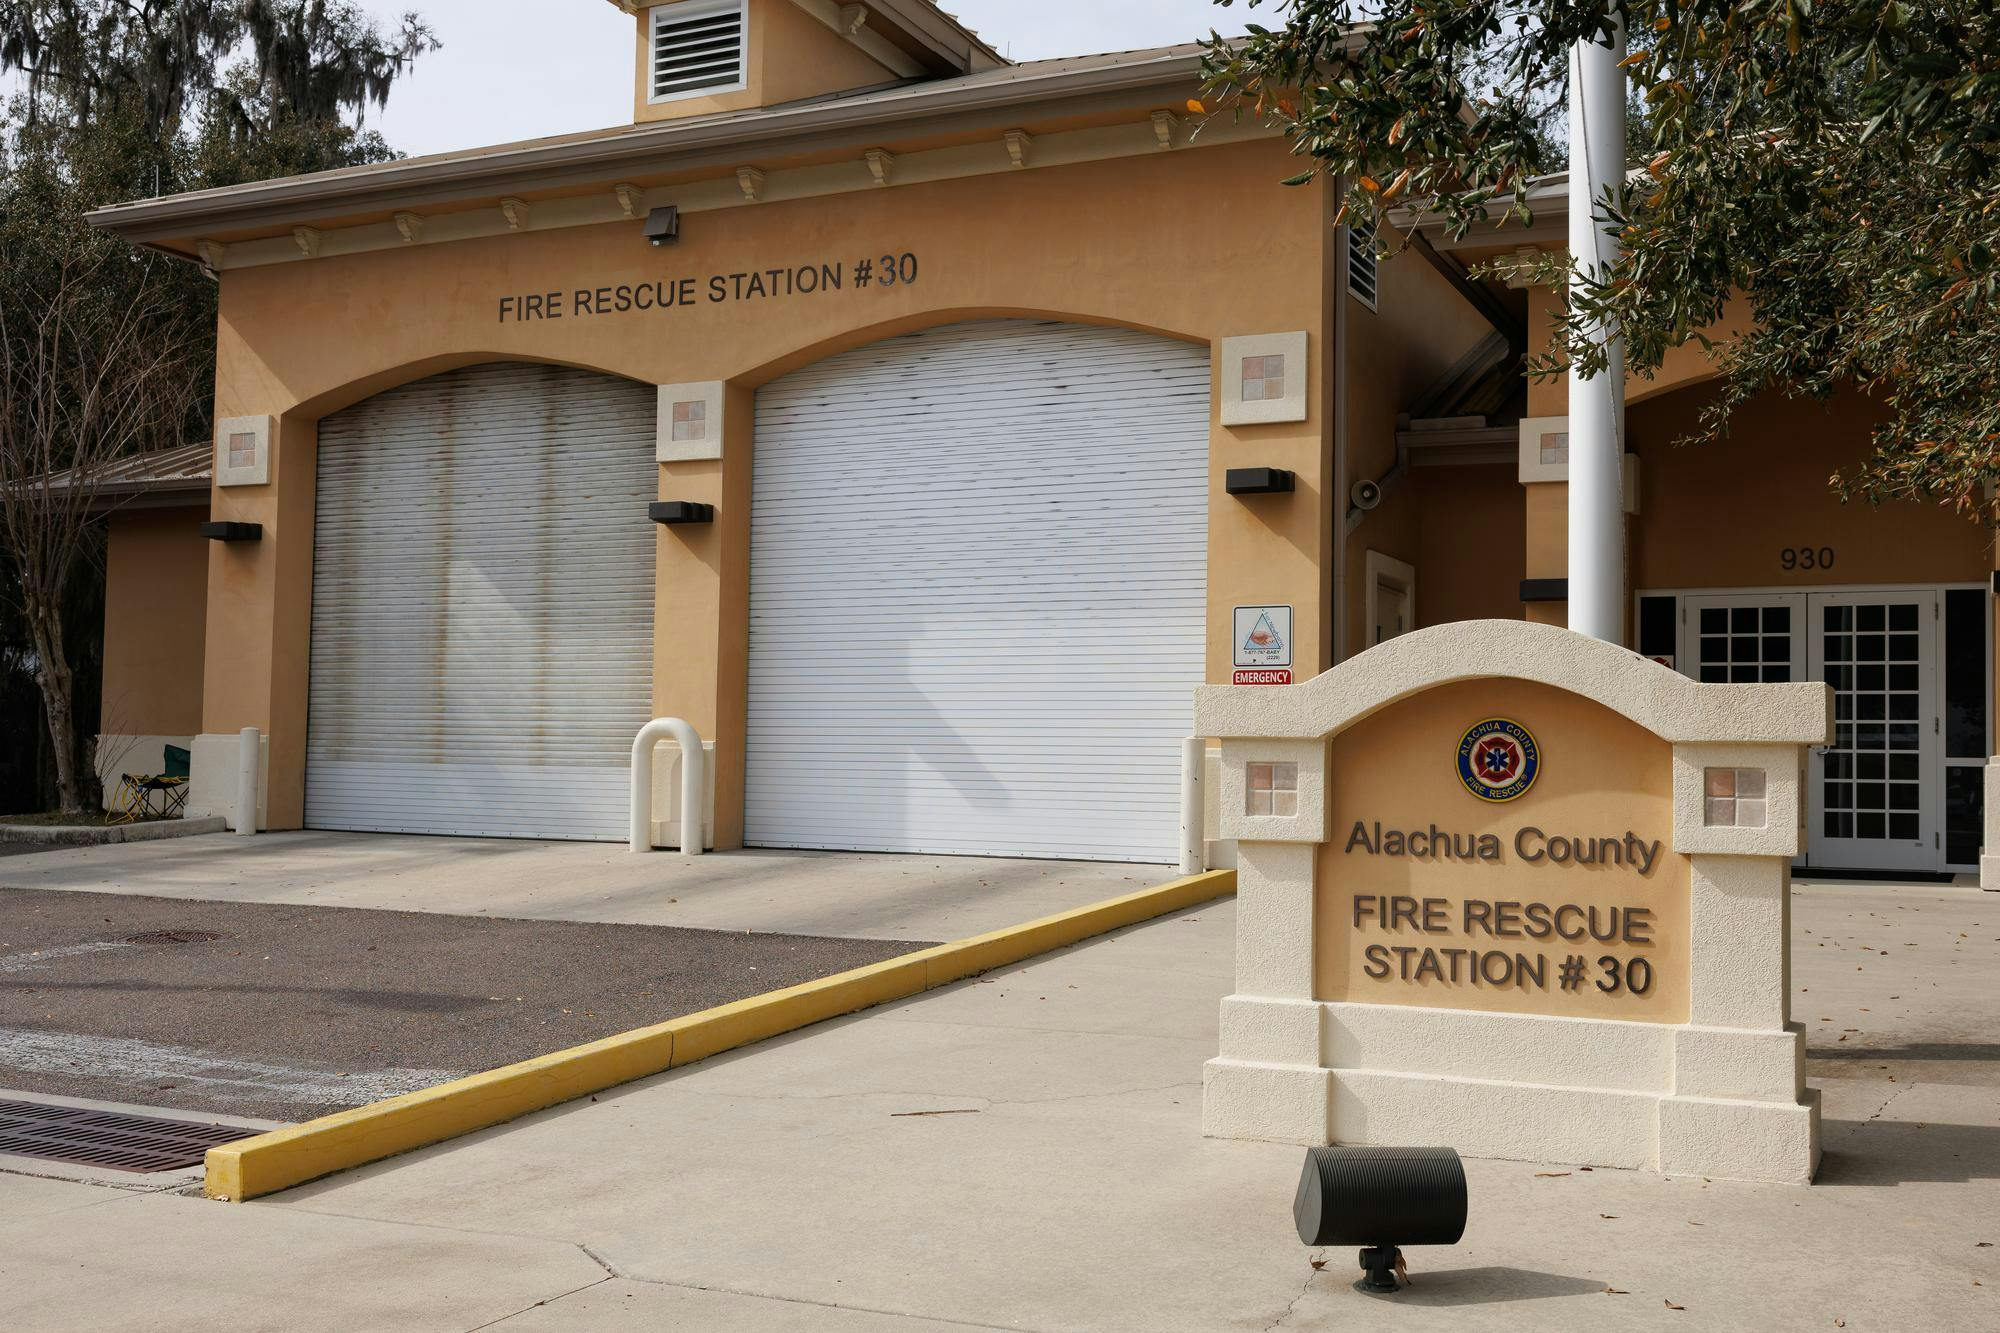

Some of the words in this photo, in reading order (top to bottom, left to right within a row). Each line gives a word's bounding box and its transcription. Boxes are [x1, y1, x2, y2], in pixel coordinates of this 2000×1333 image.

[499, 292, 562, 323] FIRE
[574, 278, 696, 316] RESCUE
[708, 262, 842, 302] STATION
[854, 252, 919, 288] #30
[1781, 547, 1835, 570] 930
[1235, 672, 1288, 683] EMERGENCY
[1461, 722, 1500, 756] ALACHUA
[1506, 724, 1535, 761] COUNTY
[1466, 776, 1486, 794] FIRE
[1344, 821, 1500, 860] Alachua
[1514, 826, 1660, 874] County
[1353, 895, 1448, 932] FIRE
[1463, 900, 1650, 942] RESCUE
[1363, 944, 1544, 987] STATION
